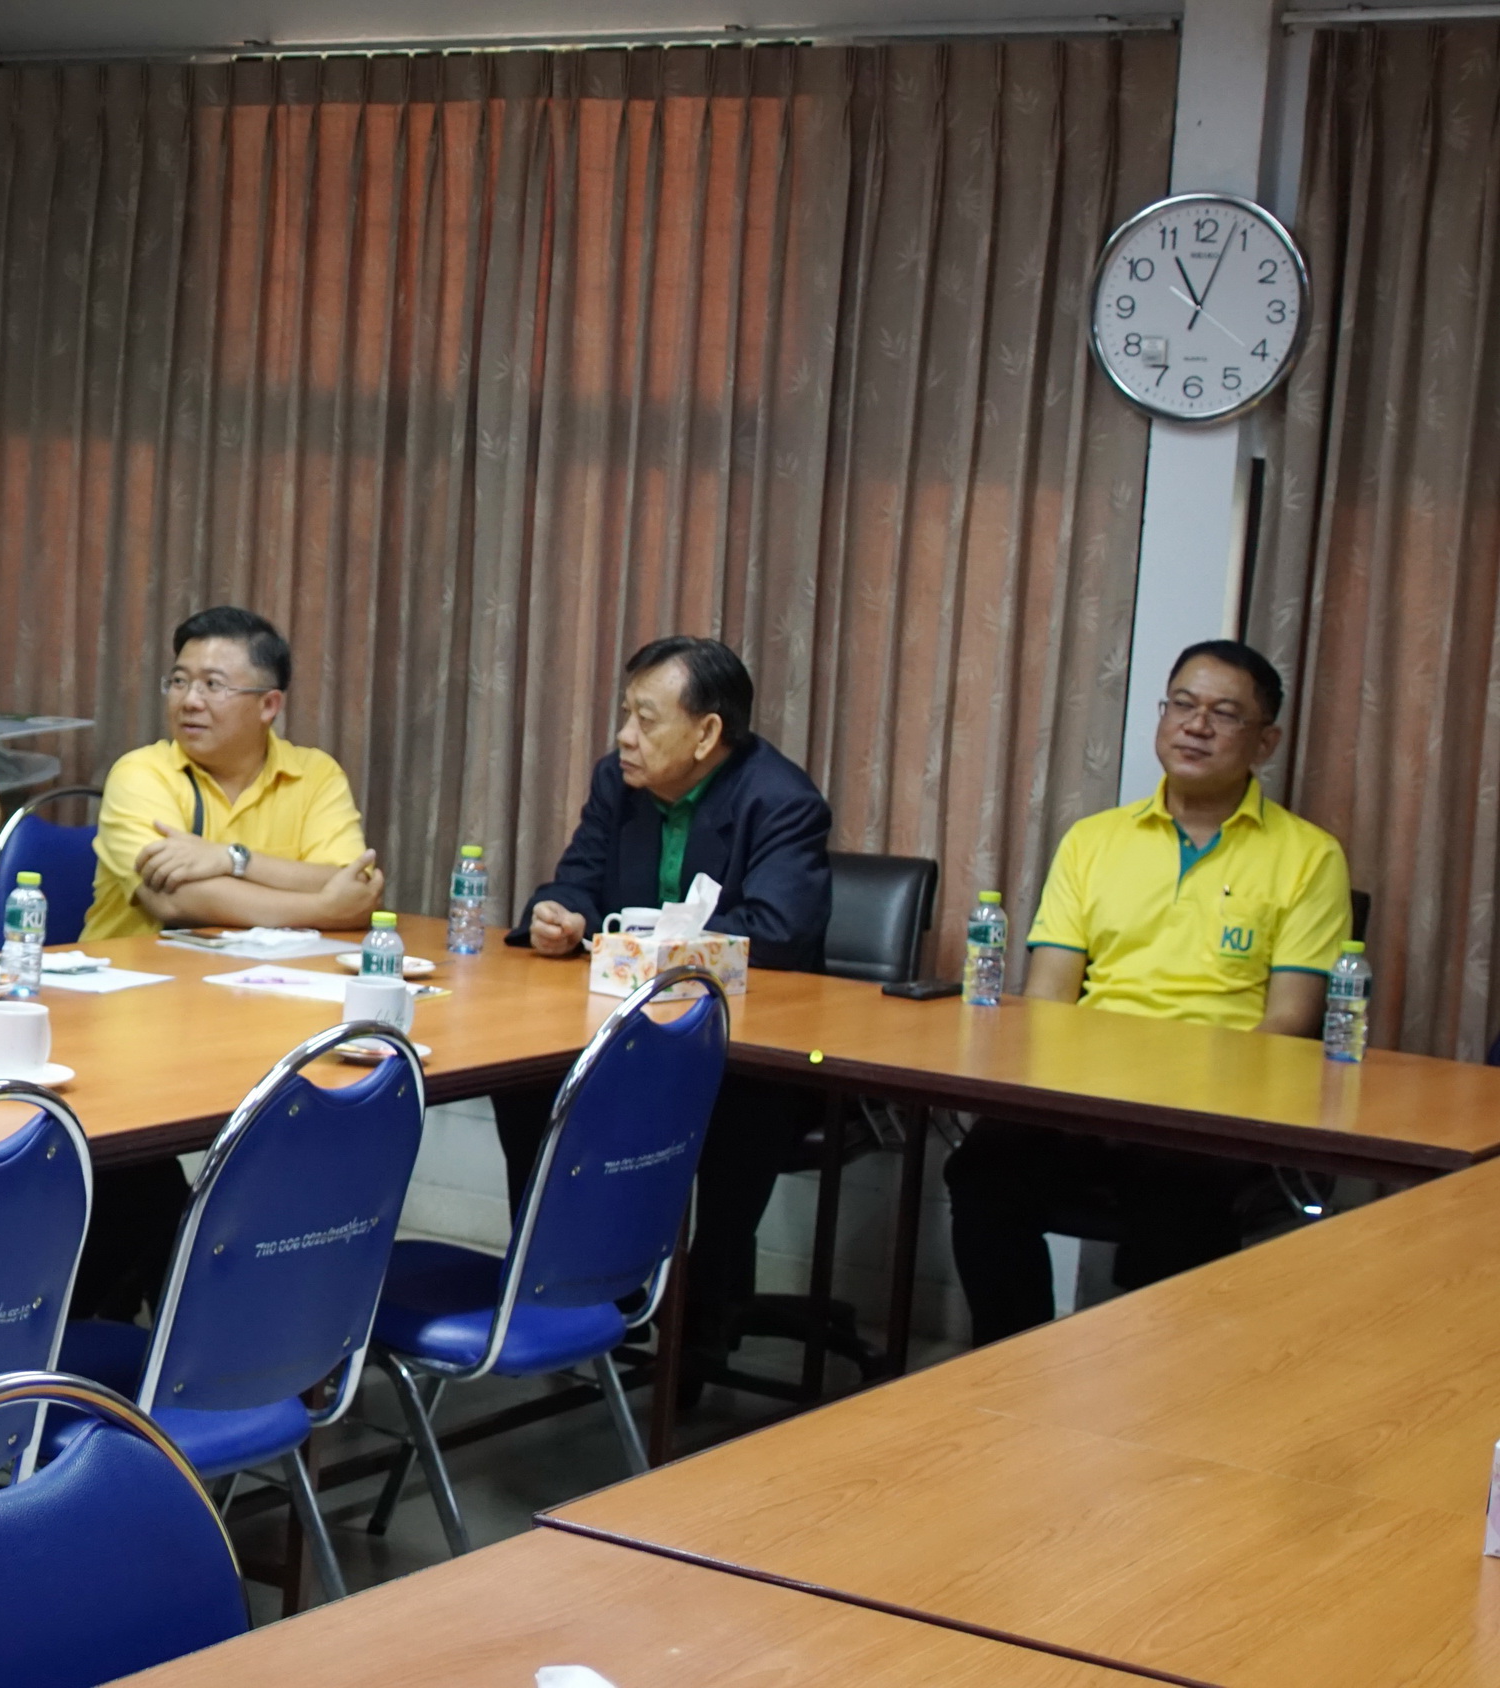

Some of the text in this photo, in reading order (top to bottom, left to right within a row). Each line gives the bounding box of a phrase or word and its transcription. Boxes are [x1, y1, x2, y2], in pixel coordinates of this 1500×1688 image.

[1160, 226, 1177, 250] 11
[1194, 218, 1219, 243] 12
[1240, 228, 1248, 251] 1
[1128, 257, 1155, 281] 10
[1258, 259, 1278, 284] 2
[1116, 295, 1135, 319] 9
[1266, 299, 1286, 324] 3
[1123, 332, 1142, 357] 8
[1251, 338, 1269, 361] 4
[1149, 364, 1169, 387] 7
[1183, 375, 1203, 398] 6
[1222, 367, 1241, 390] 5
[23, 911, 46, 928] KU
[1221, 925, 1253, 951] KU
